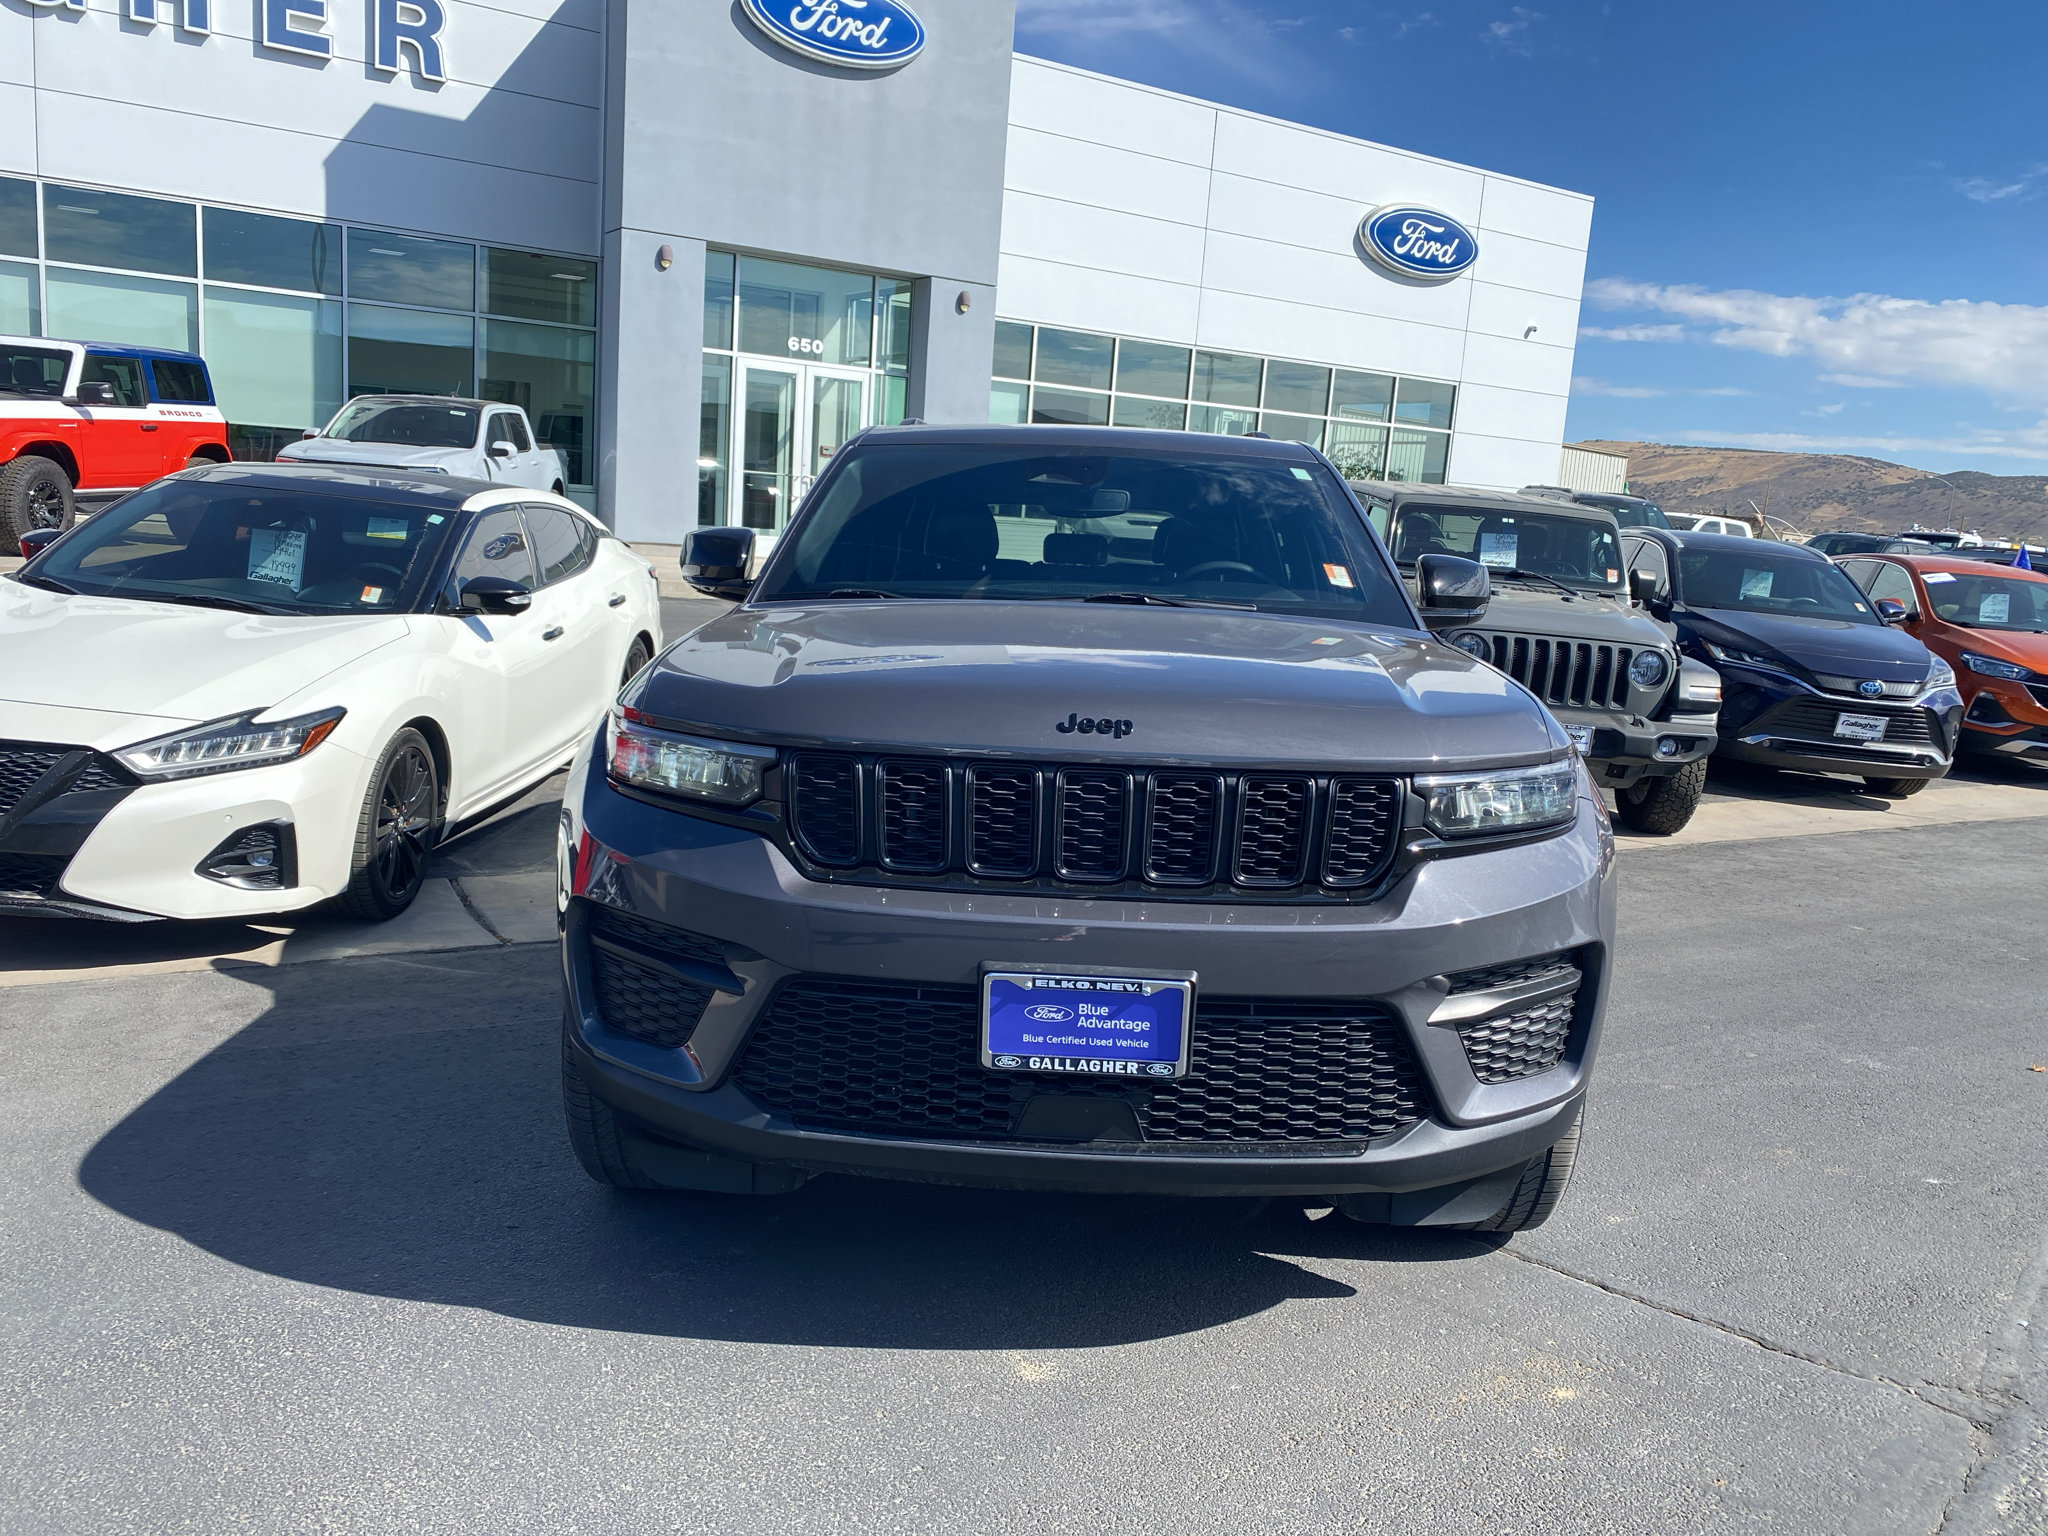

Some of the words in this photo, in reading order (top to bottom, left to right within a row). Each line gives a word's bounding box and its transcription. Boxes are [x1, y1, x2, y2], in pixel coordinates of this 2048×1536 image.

[789, 0, 892, 48] Ford
[1393, 218, 1460, 264] Ford
[787, 336, 824, 354] 650
[158, 409, 203, 417] BRONCO
[249, 571, 294, 585] Gallagher
[1056, 713, 1134, 739] Jeep
[1841, 719, 1881, 730] Gallagher
[1035, 979, 1093, 990] ELKO.
[1096, 982, 1140, 992] NEV.
[1033, 1006, 1065, 1020] Ford
[1078, 1003, 1109, 1016] Blue
[1077, 1016, 1151, 1033] Advantage
[1022, 1033, 1044, 1043] Blue
[1046, 1035, 1086, 1046] Certified
[1089, 1037, 1113, 1047] Used
[1115, 1038, 1149, 1049] Vehicle
[1029, 1056, 1138, 1075] GALLAGHER
